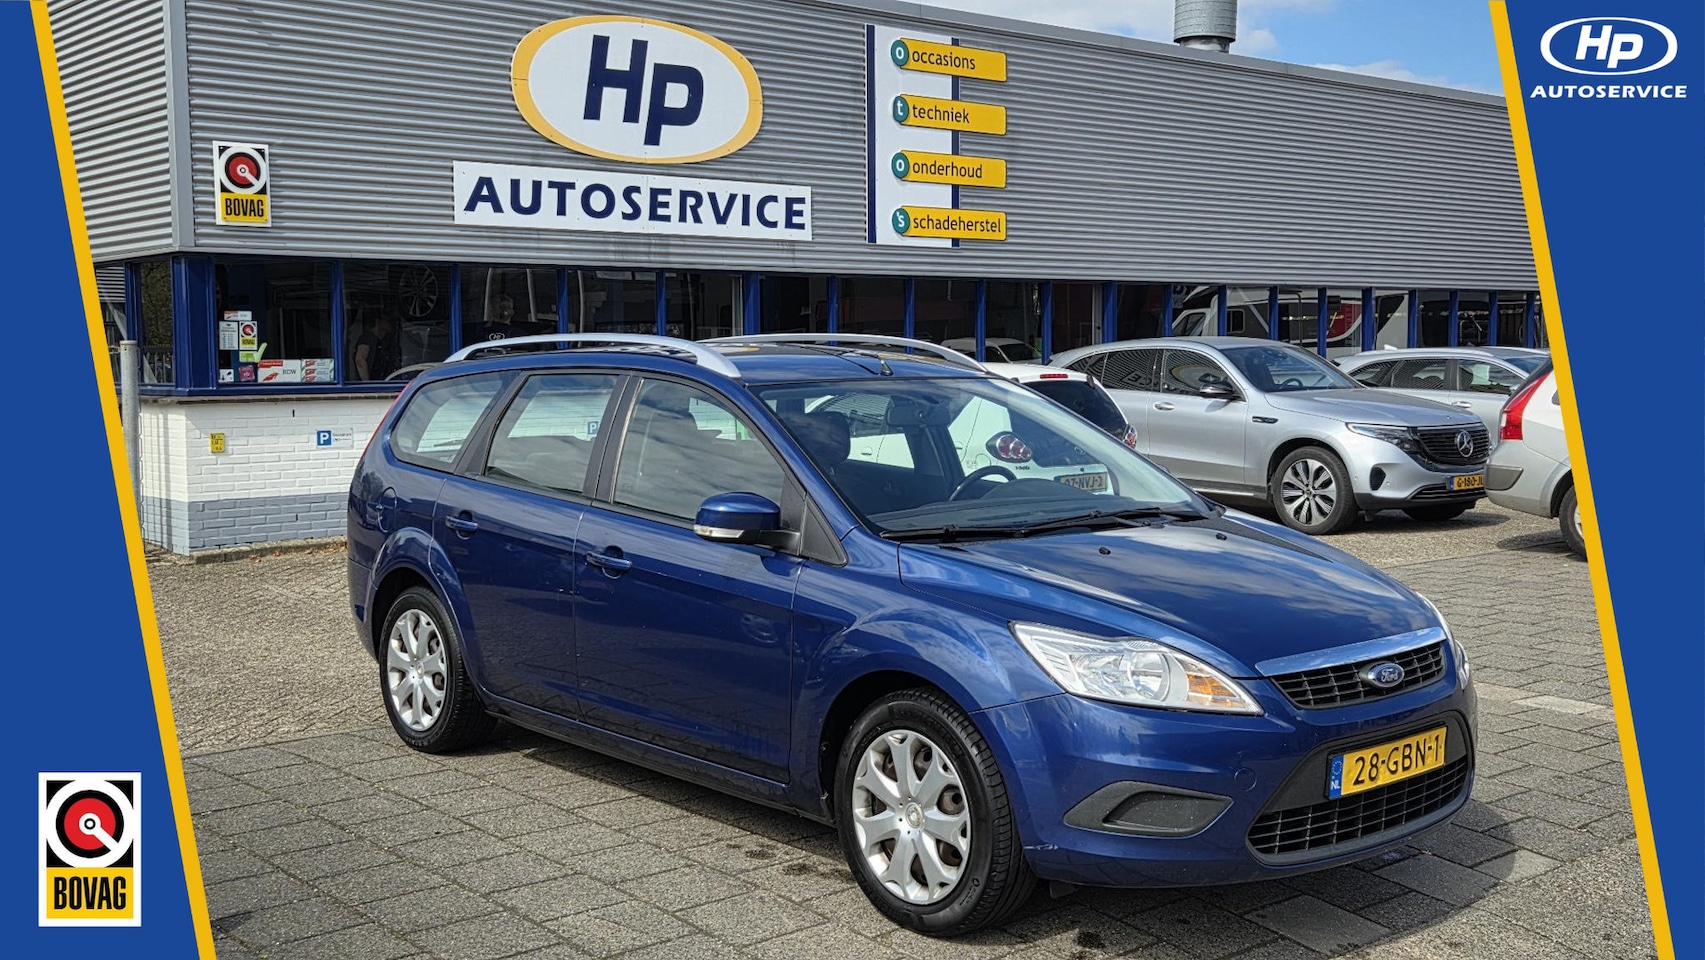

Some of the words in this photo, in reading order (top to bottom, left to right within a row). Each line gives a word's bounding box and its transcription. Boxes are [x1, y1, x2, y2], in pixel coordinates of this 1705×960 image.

[912, 50, 976, 70] occasions
[582, 34, 705, 147] Hp
[912, 104, 970, 124] techniek
[912, 161, 983, 179] onderhoud
[225, 198, 264, 217] BOVAG
[463, 176, 807, 231] AUTOSERVICE
[913, 214, 1001, 233] schadeherstel
[320, 432, 329, 444] P
[1381, 669, 1398, 682] Ford
[1353, 734, 1439, 786] 28-GBN-1
[1330, 780, 1341, 790] NL
